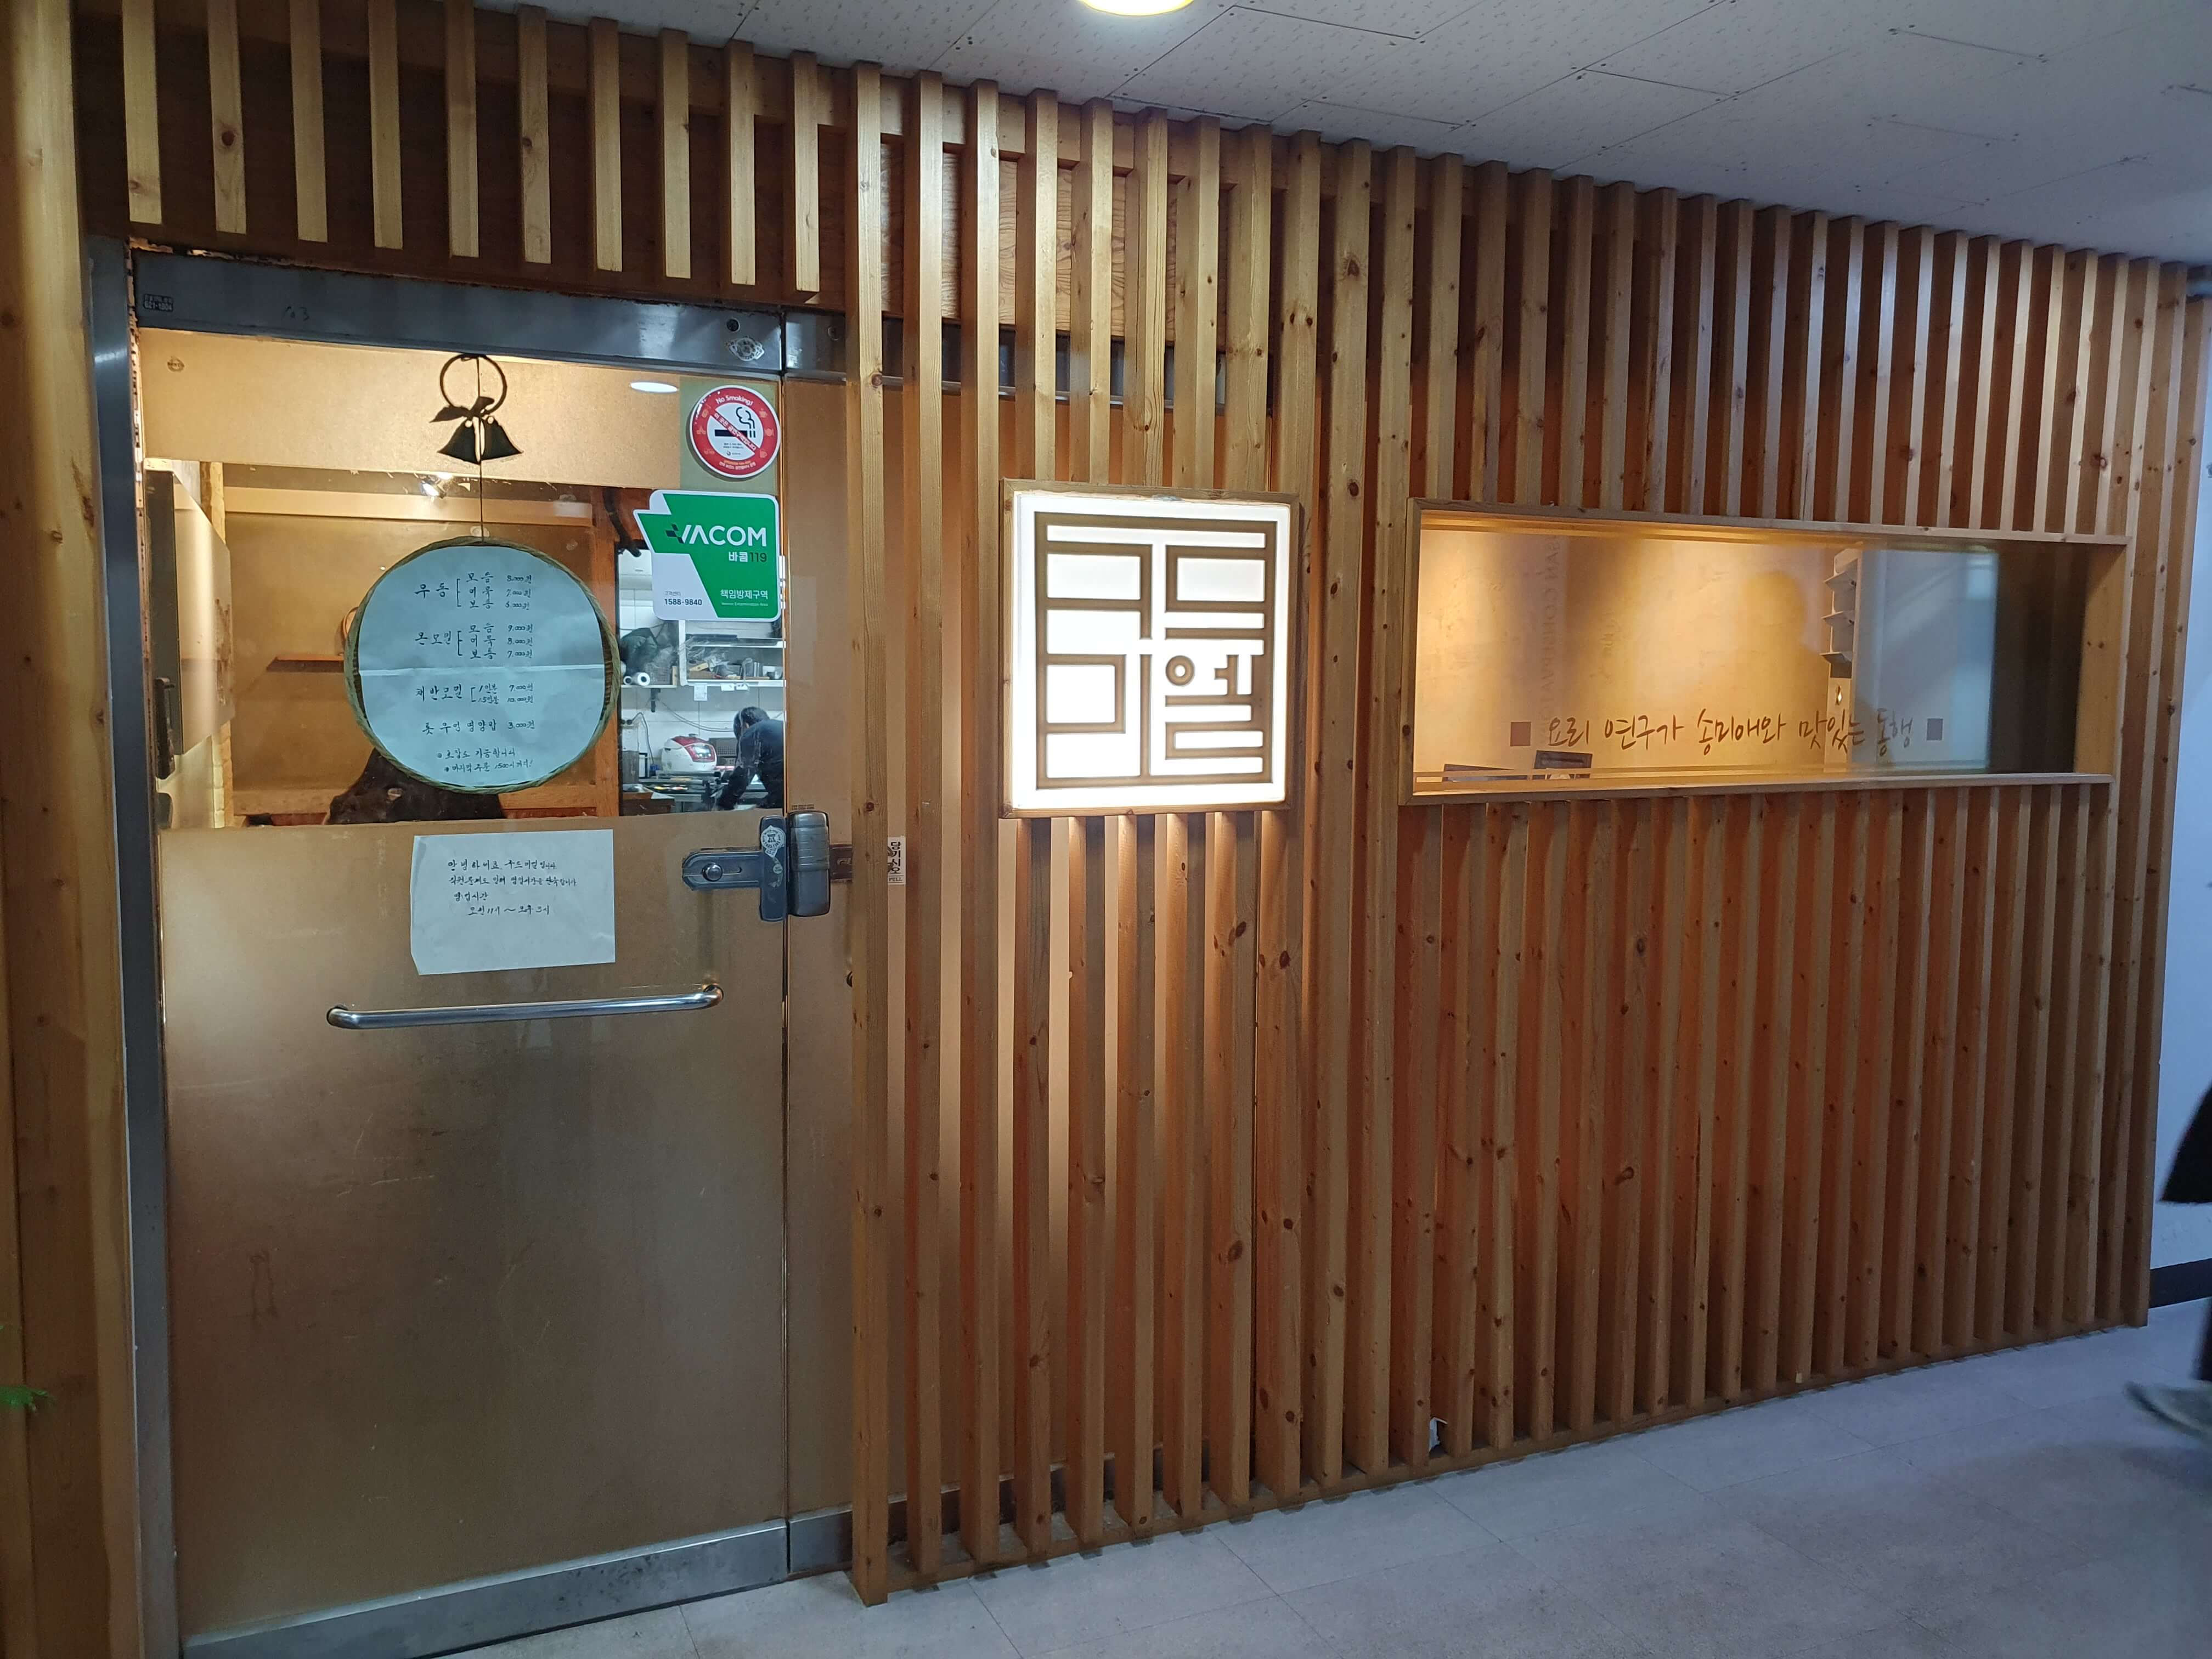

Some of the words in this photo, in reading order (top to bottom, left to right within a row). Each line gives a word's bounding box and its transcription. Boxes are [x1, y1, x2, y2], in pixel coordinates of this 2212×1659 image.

[725, 394, 754, 407] Smoking!
[675, 524, 768, 548] VACOM
[720, 589, 769, 600] 책임방제구역
[1548, 713, 1590, 748] 요리
[1604, 714, 1684, 751] 연구가
[1697, 707, 1787, 757] 송미애와
[1799, 708, 1865, 751] 맛있는
[1877, 709, 1914, 758] 동행
[889, 842, 901, 874] 당기시오
[453, 891, 489, 902] 영업시간
